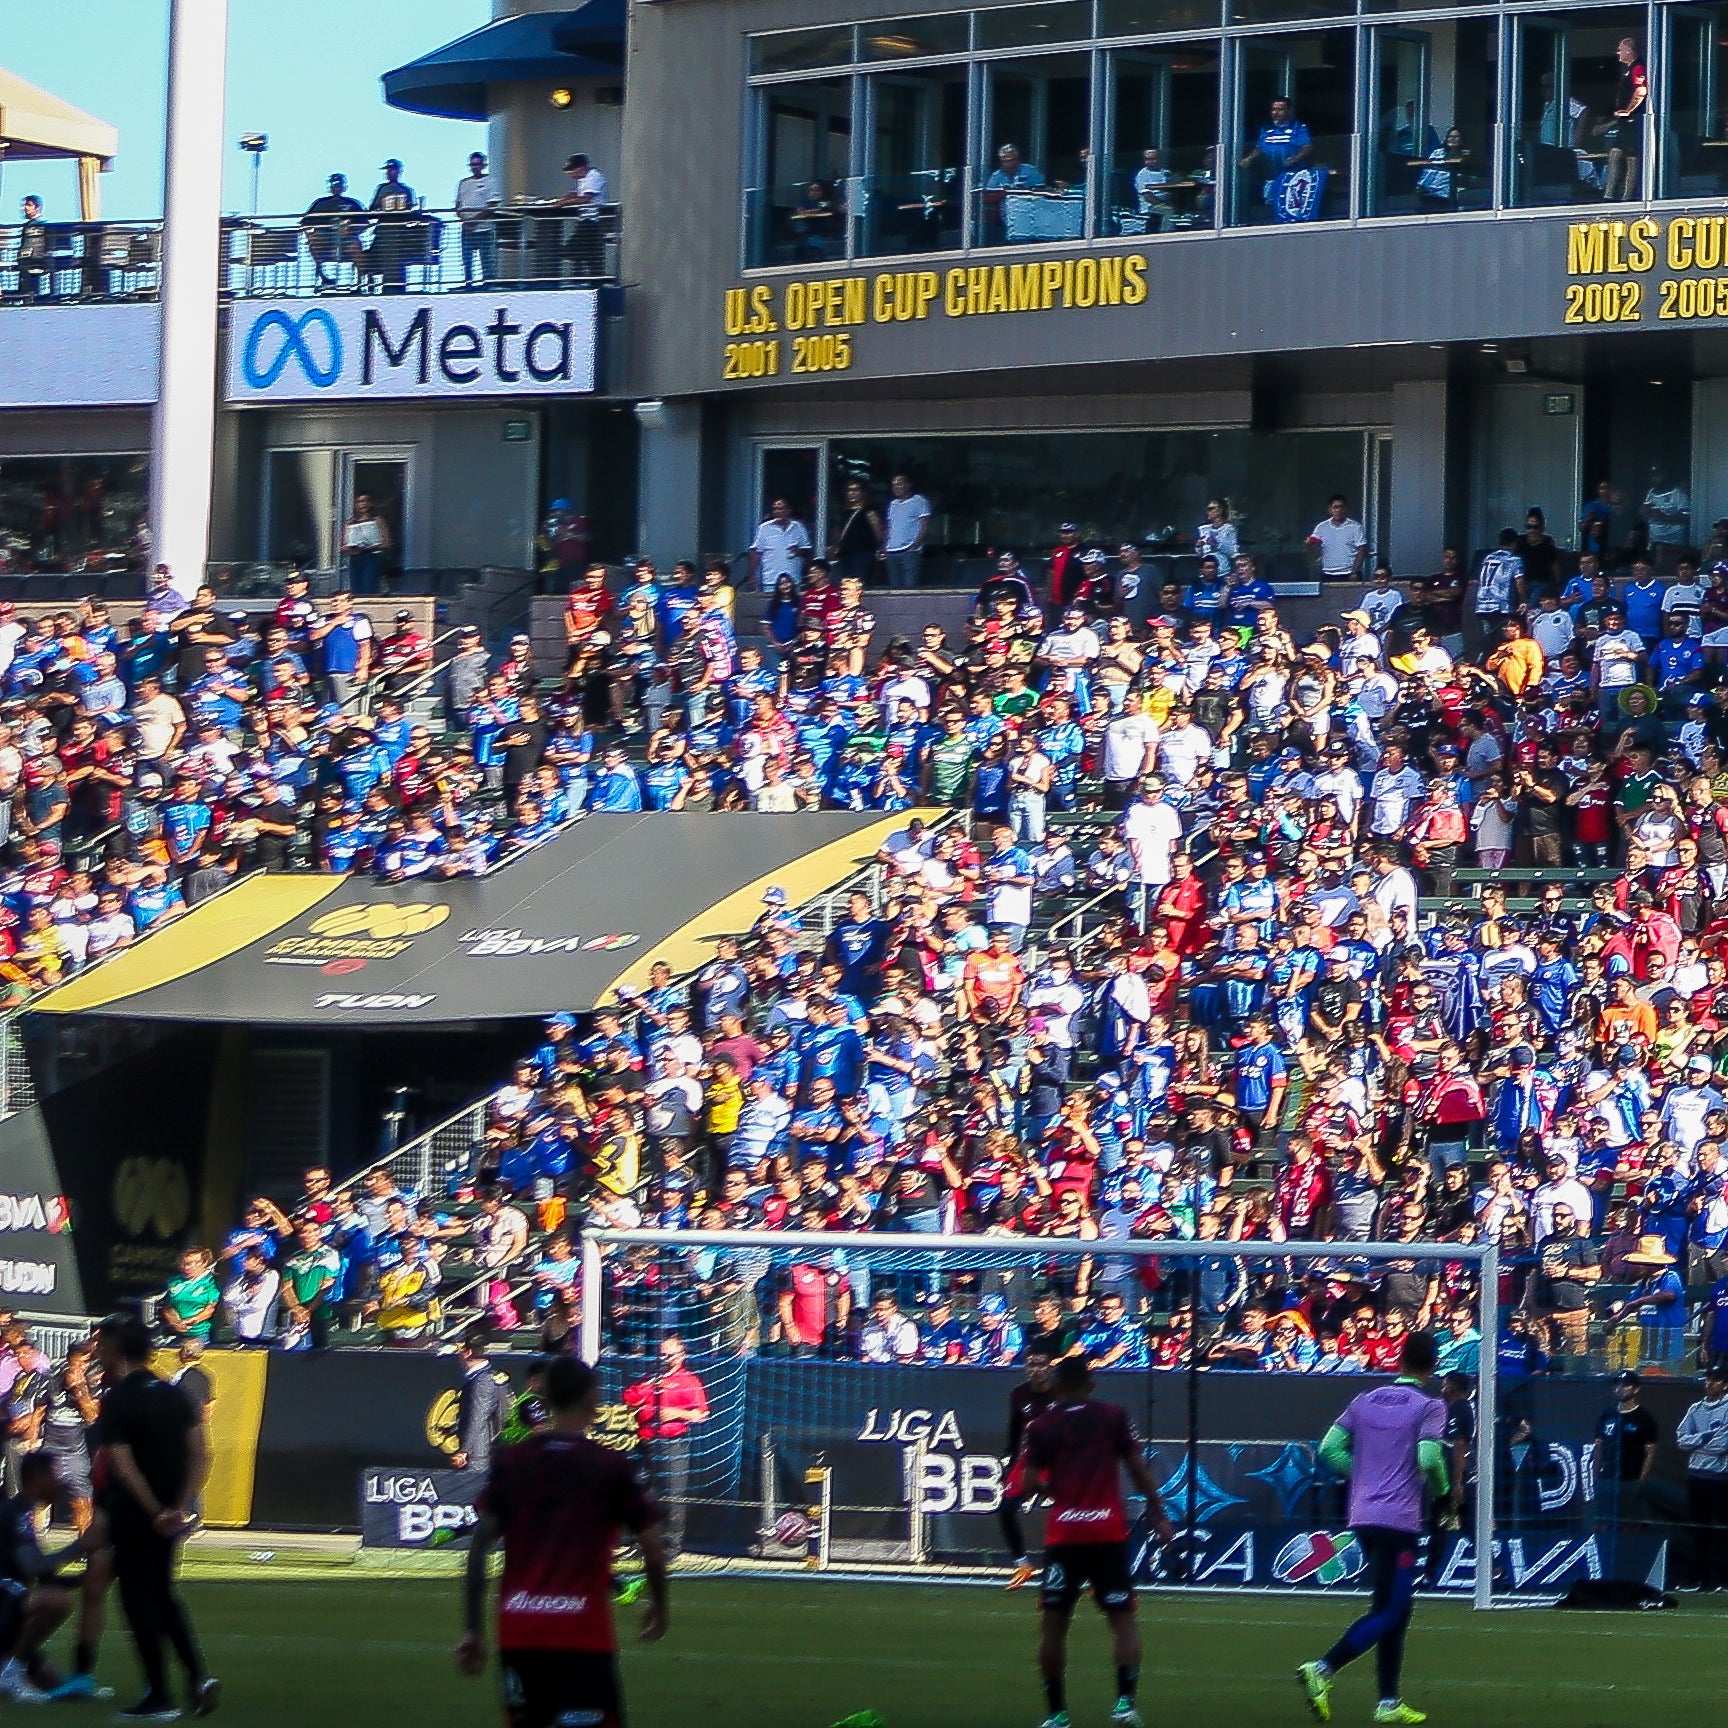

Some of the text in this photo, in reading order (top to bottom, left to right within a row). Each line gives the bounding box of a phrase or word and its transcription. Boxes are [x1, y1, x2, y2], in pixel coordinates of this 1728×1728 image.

[1567, 218, 1658, 275] MLS
[724, 254, 1149, 336] U.S. OPEN CUP CHAMPIONS
[1564, 281, 1642, 324] 2002
[362, 306, 574, 386] Meta
[722, 333, 852, 379] 2001 2005
[457, 928, 524, 943] LIGA
[467, 936, 580, 956] BBVA
[313, 992, 438, 1010] TUDN
[858, 1408, 968, 1451] LIGA
[366, 1473, 440, 1505] LIGA
